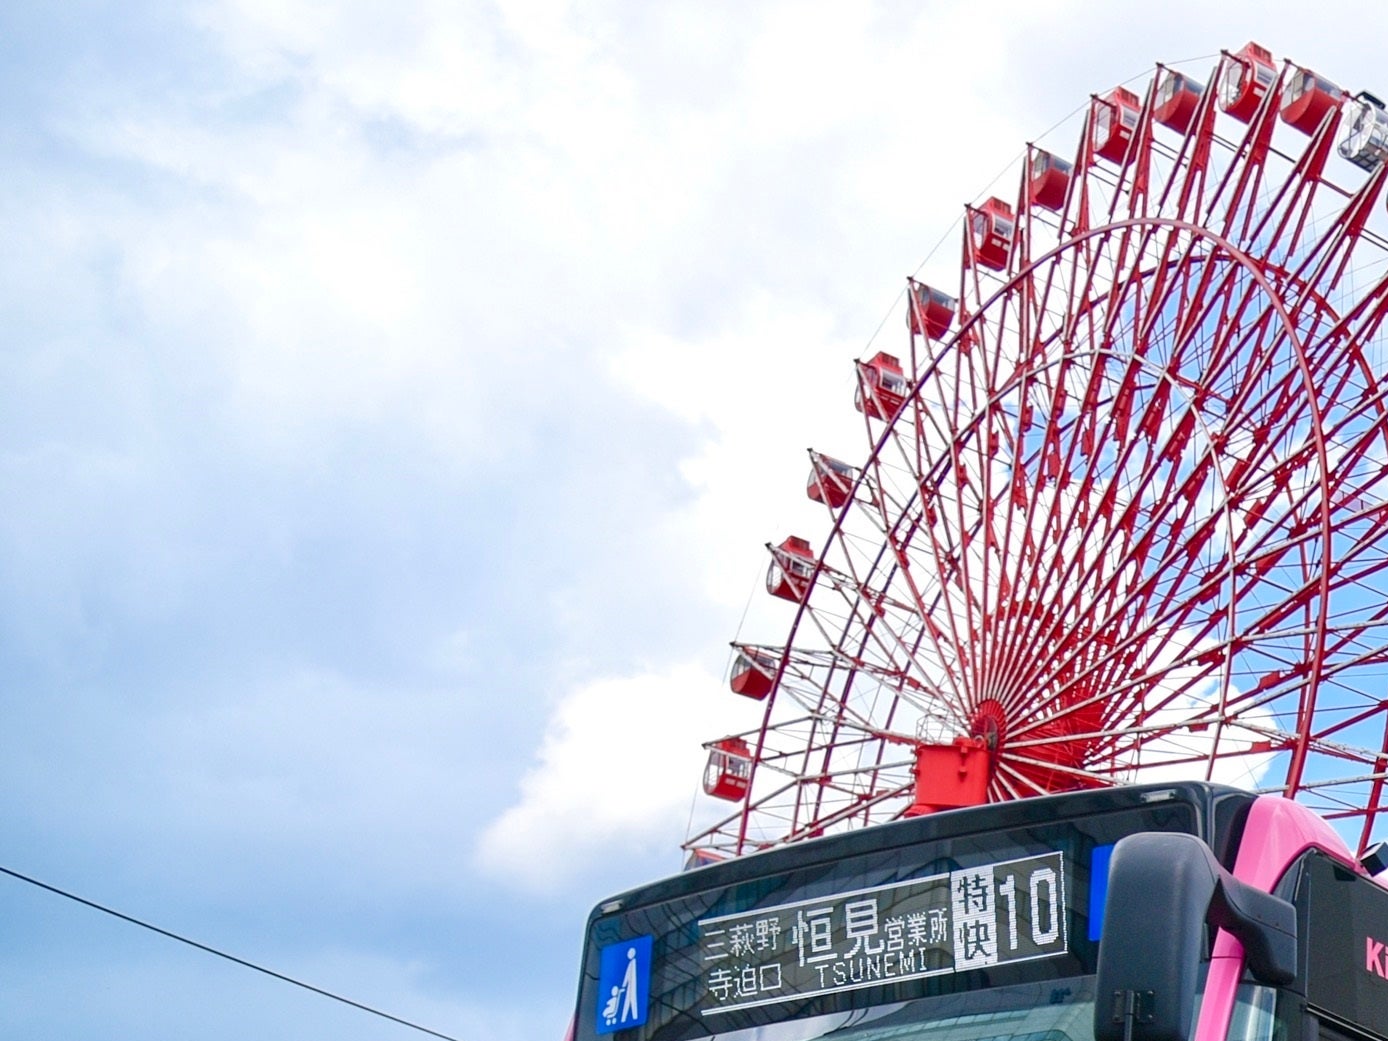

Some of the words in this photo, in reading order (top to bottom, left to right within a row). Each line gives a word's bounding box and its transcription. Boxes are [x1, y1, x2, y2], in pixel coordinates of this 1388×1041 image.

[704, 916, 781, 961] 三萩野
[958, 873, 993, 962] 特快
[1000, 867, 1059, 950] 10
[708, 963, 782, 1000] 寺迫口
[814, 948, 927, 988] TSUNEMI
